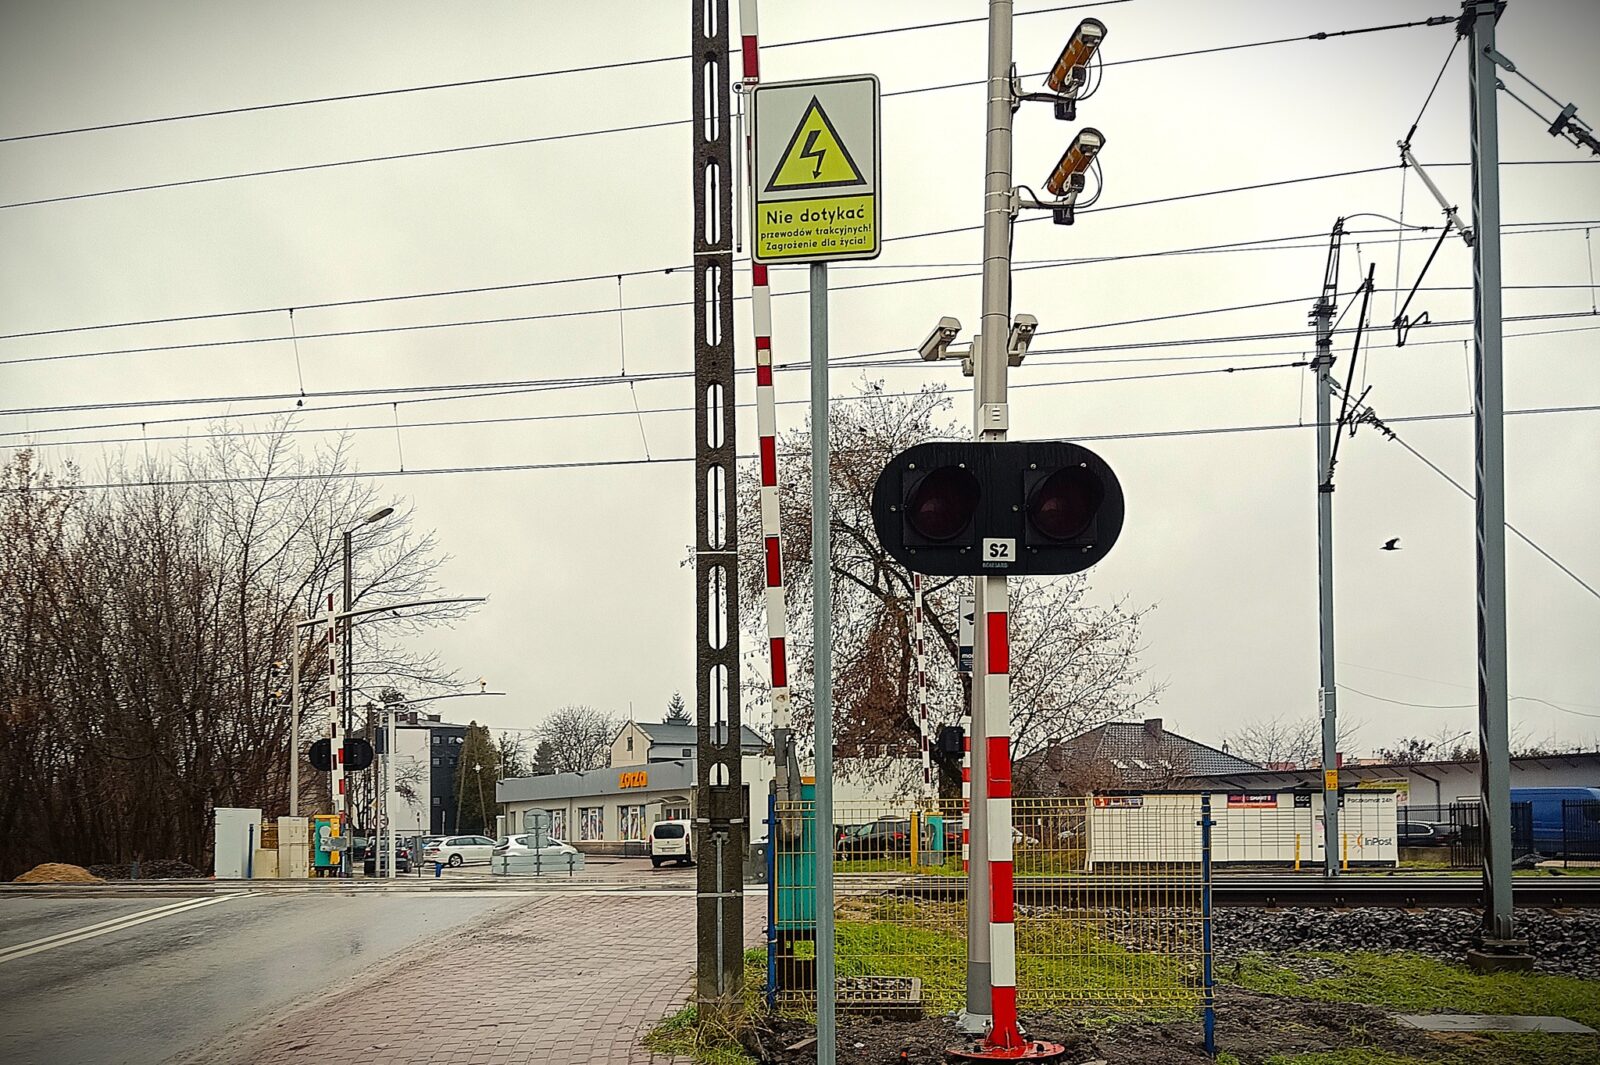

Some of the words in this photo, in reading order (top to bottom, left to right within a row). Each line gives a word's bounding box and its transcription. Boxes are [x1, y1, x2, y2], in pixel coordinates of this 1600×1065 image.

[766, 210, 793, 225] Nie
[800, 204, 865, 224] dotykać
[760, 228, 812, 241] przewodów
[815, 223, 872, 235] trakcyjnych!
[766, 240, 818, 252] Zagrożenie
[821, 238, 836, 247] dla
[840, 235, 866, 247] życia!
[989, 543, 1009, 558] S2
[1364, 837, 1392, 846] InPost
